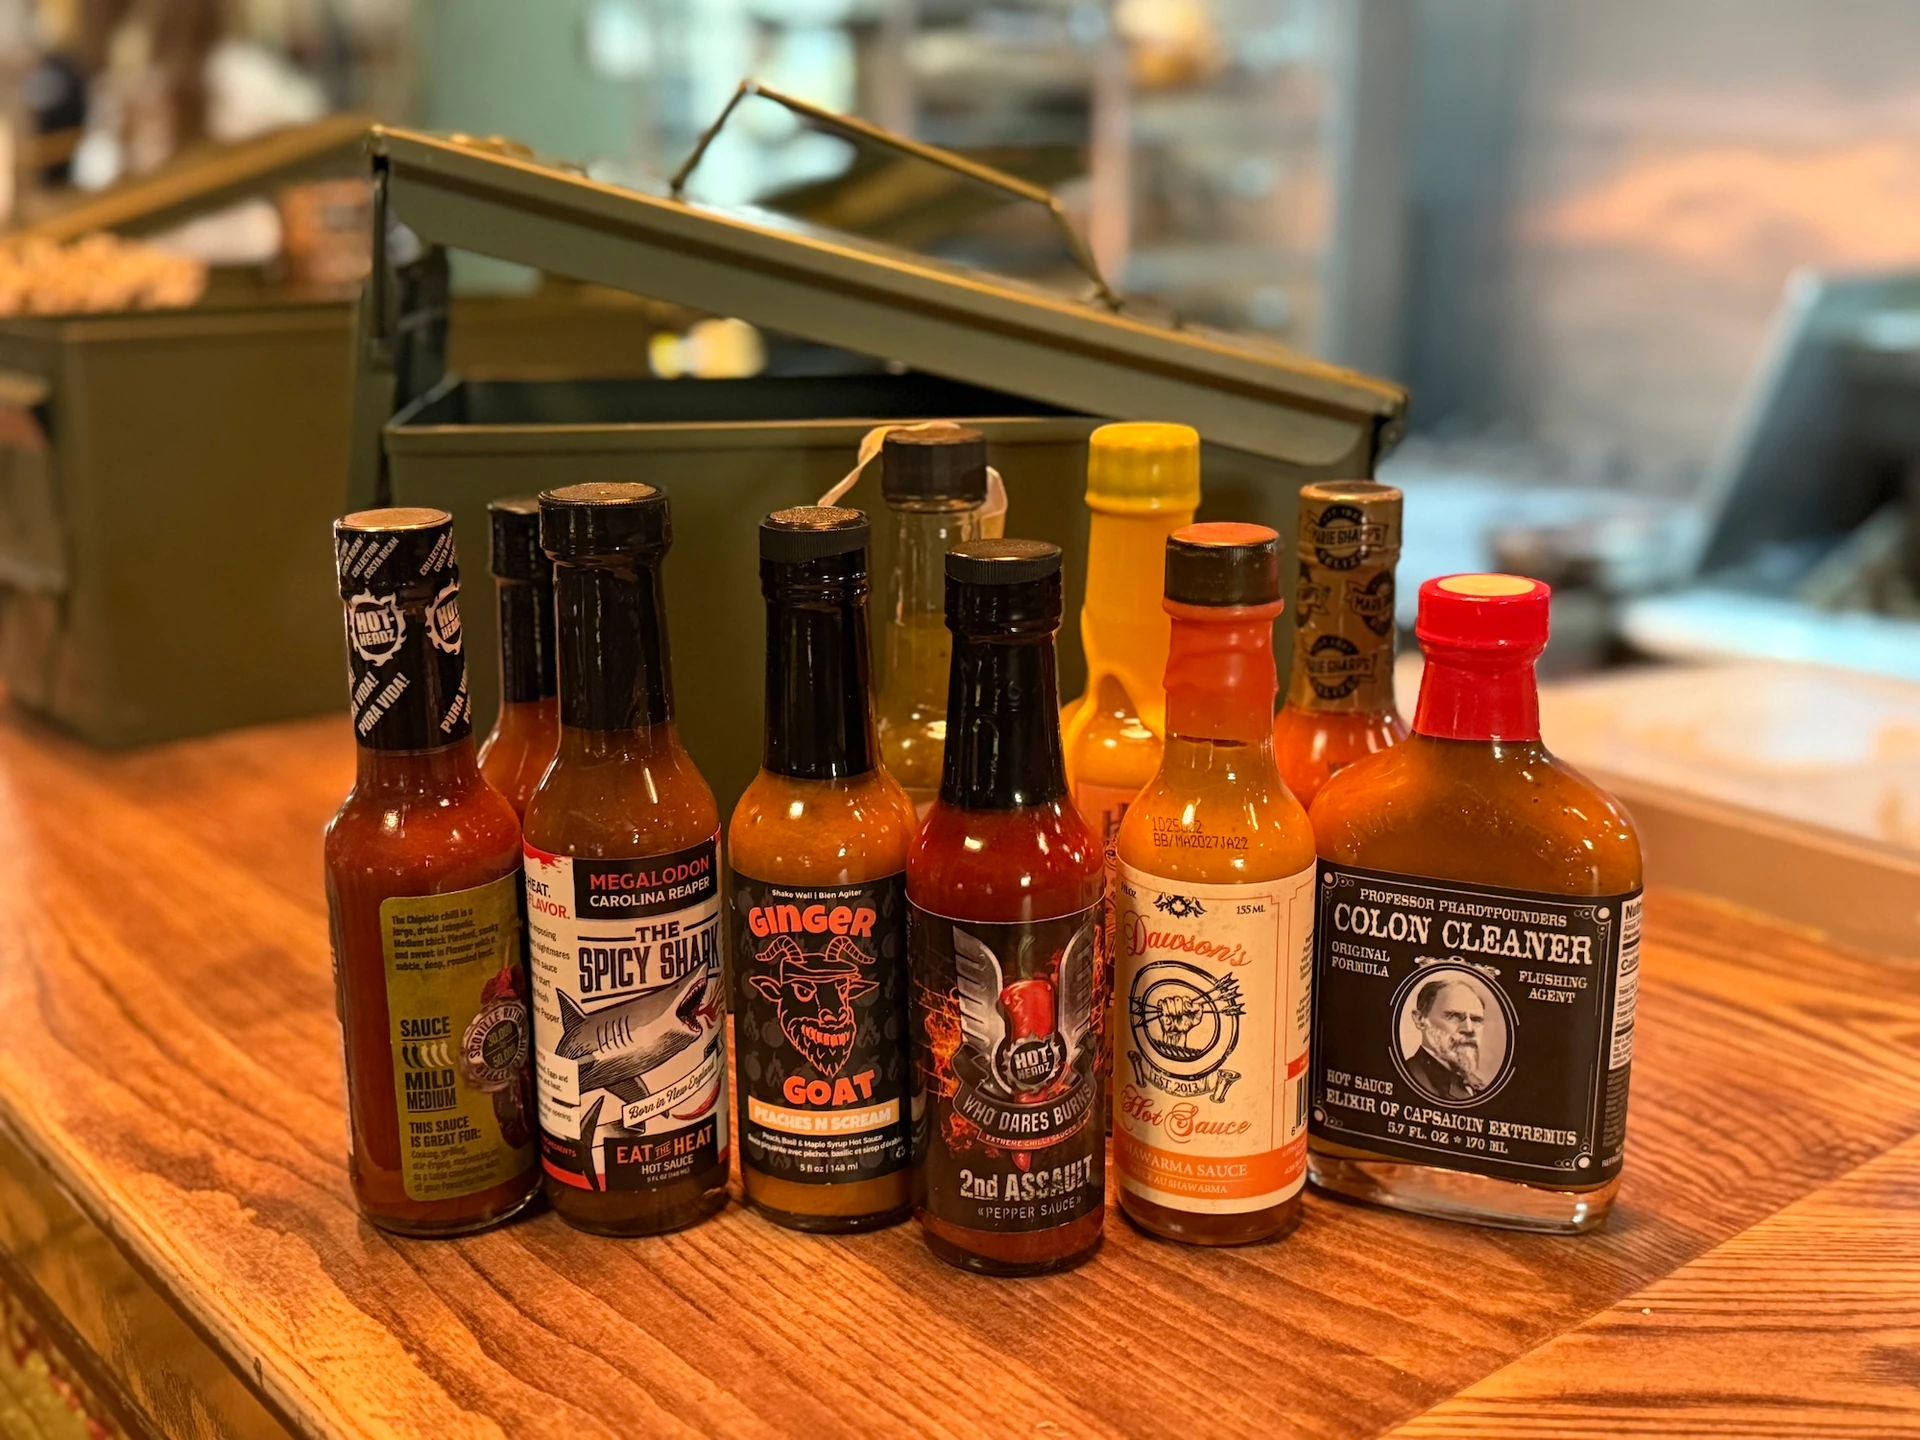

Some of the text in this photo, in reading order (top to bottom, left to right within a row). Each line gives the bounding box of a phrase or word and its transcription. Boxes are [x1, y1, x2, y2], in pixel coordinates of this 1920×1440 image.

[351, 541, 380, 578] COLLECTION
[363, 536, 400, 579] COSTA RICAN
[420, 533, 446, 576] COLLECTION
[358, 628, 397, 647] HEADZ
[358, 672, 411, 737] PURA VIDA!
[440, 694, 465, 734] PURA
[590, 855, 709, 890] MEGALODON
[590, 876, 710, 907] CAROLINA REAPER
[772, 889, 794, 898] Shake
[529, 892, 570, 919] FLAVOR.
[1236, 904, 1266, 914] 155 ML
[1359, 888, 1567, 927] PROFESSOR PHARDTPOUNDERS
[417, 924, 439, 935] dried
[635, 921, 680, 943] THE
[1122, 910, 1253, 967] Dawson's
[1334, 902, 1593, 966] COLON CLEANER
[395, 951, 408, 959] and
[578, 922, 720, 993] SPICY SHARK
[1331, 940, 1391, 963] ORIGINAL
[1331, 955, 1390, 978] FORMULA
[1518, 970, 1589, 989] FLUSHING
[1528, 987, 1576, 1004] AGENT
[401, 1016, 451, 1037] SAUCE
[405, 1069, 455, 1091] MILD
[1017, 1062, 1051, 1080] HEADZ
[1326, 1069, 1394, 1096] HOT SAUCE
[783, 1069, 875, 1107] GOAT
[1153, 1075, 1199, 1093] EST. 2013
[406, 1088, 457, 1110] MEDIUM
[629, 1105, 655, 1119] Born
[656, 1097, 666, 1108] in
[666, 1087, 688, 1103] New
[962, 1082, 1093, 1133] WHO DARES BURNS
[409, 1116, 470, 1134] THIS SAUCE
[755, 1105, 892, 1131] PEACHES N SCREAM
[1121, 1084, 1252, 1144] Hot Sauce
[1326, 1088, 1578, 1146] ELIXIR OF CAPSAICIN EXTREMUS
[411, 1128, 482, 1148] IS GREAT FOR:
[617, 1124, 713, 1164] EAT THE HEAT
[827, 1140, 848, 1149] Syrup
[849, 1139, 862, 1147] Hot
[863, 1134, 884, 1144] Sauce
[1388, 1121, 1509, 1153] 5.7 FL. OZ 170 ML
[641, 1154, 694, 1175] HOT SAUCE
[831, 1163, 846, 1173] 148
[847, 1162, 859, 1171] ml
[1197, 1163, 1248, 1177] SAUCE
[960, 1168, 999, 1200] 2nd
[1004, 1153, 1093, 1202] ASSAULT
[1153, 1175, 1228, 1194] AU SHAWARMA
